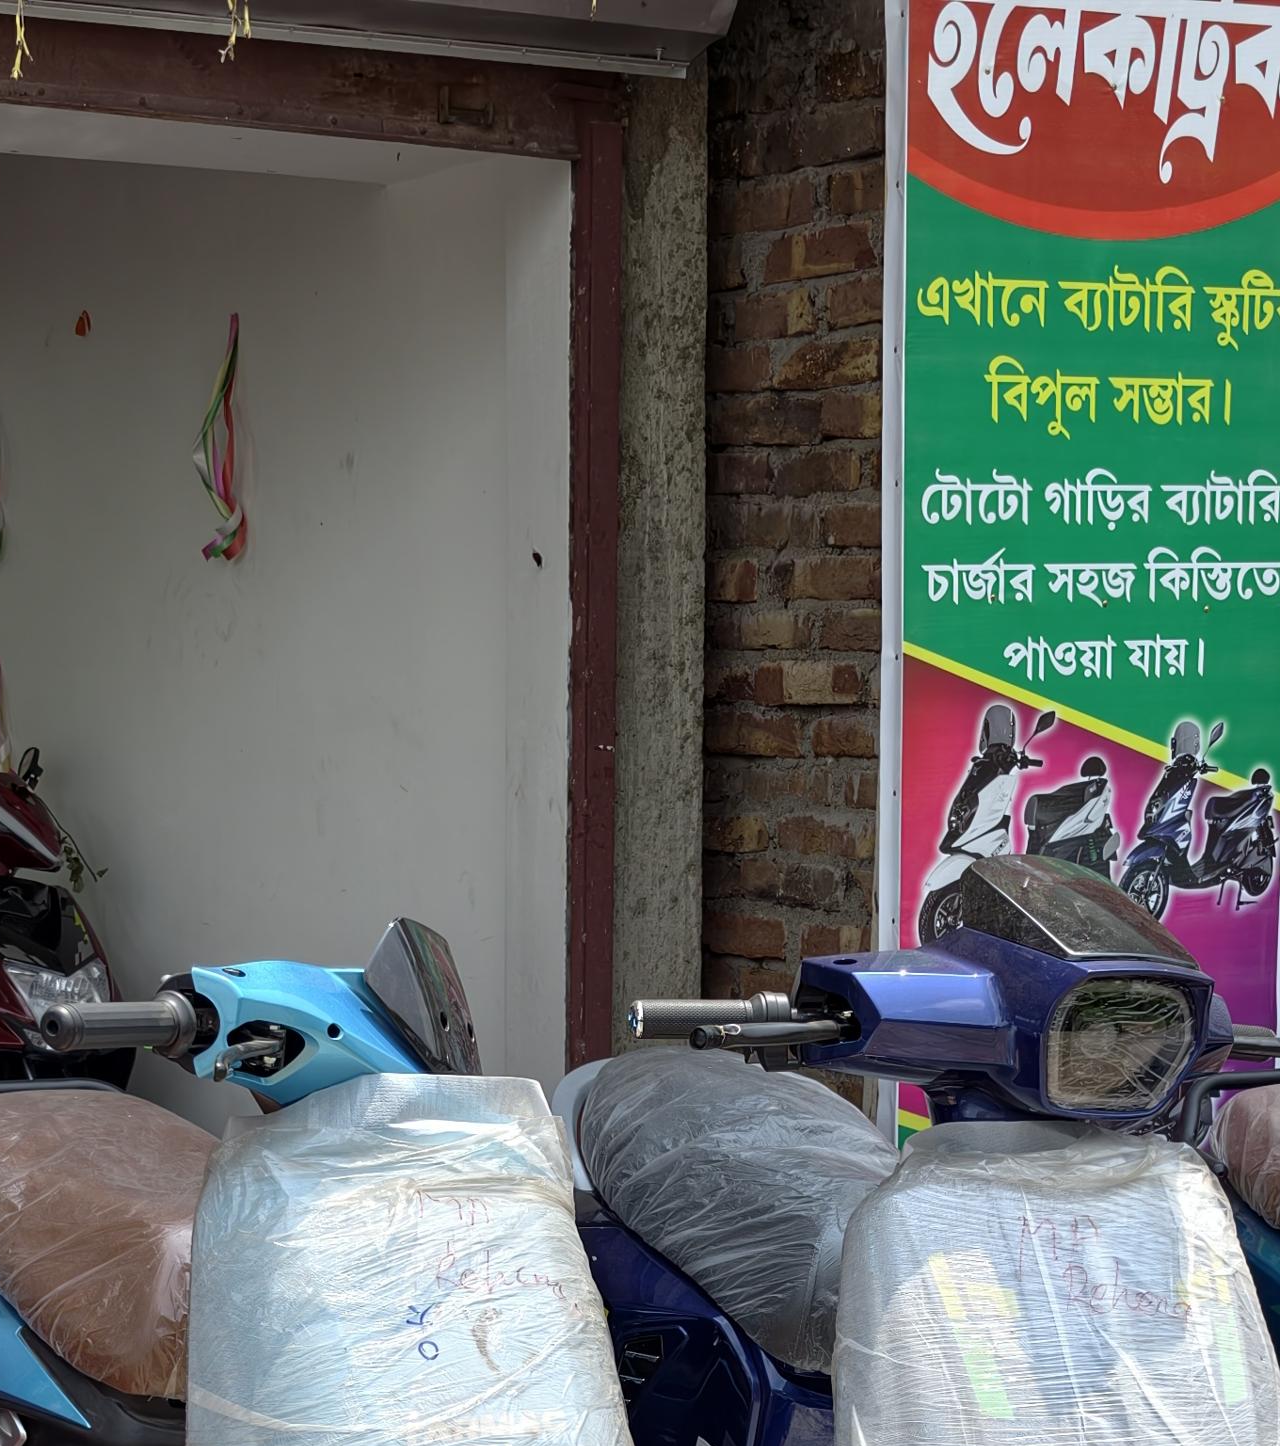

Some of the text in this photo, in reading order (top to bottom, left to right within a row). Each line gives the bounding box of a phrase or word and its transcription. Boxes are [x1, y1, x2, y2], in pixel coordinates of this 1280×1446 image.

[918, 270, 1049, 328] এখানে
[1058, 265, 1195, 333] ব্যাটারি
[984, 355, 1100, 440] বিপুল
[921, 468, 1033, 526] টোটো
[1044, 467, 1152, 531] গাড়ির
[921, 547, 1036, 605] চার্জার
[1043, 562, 1137, 608] সহজ
[1003, 634, 1117, 682] পাওয়া
